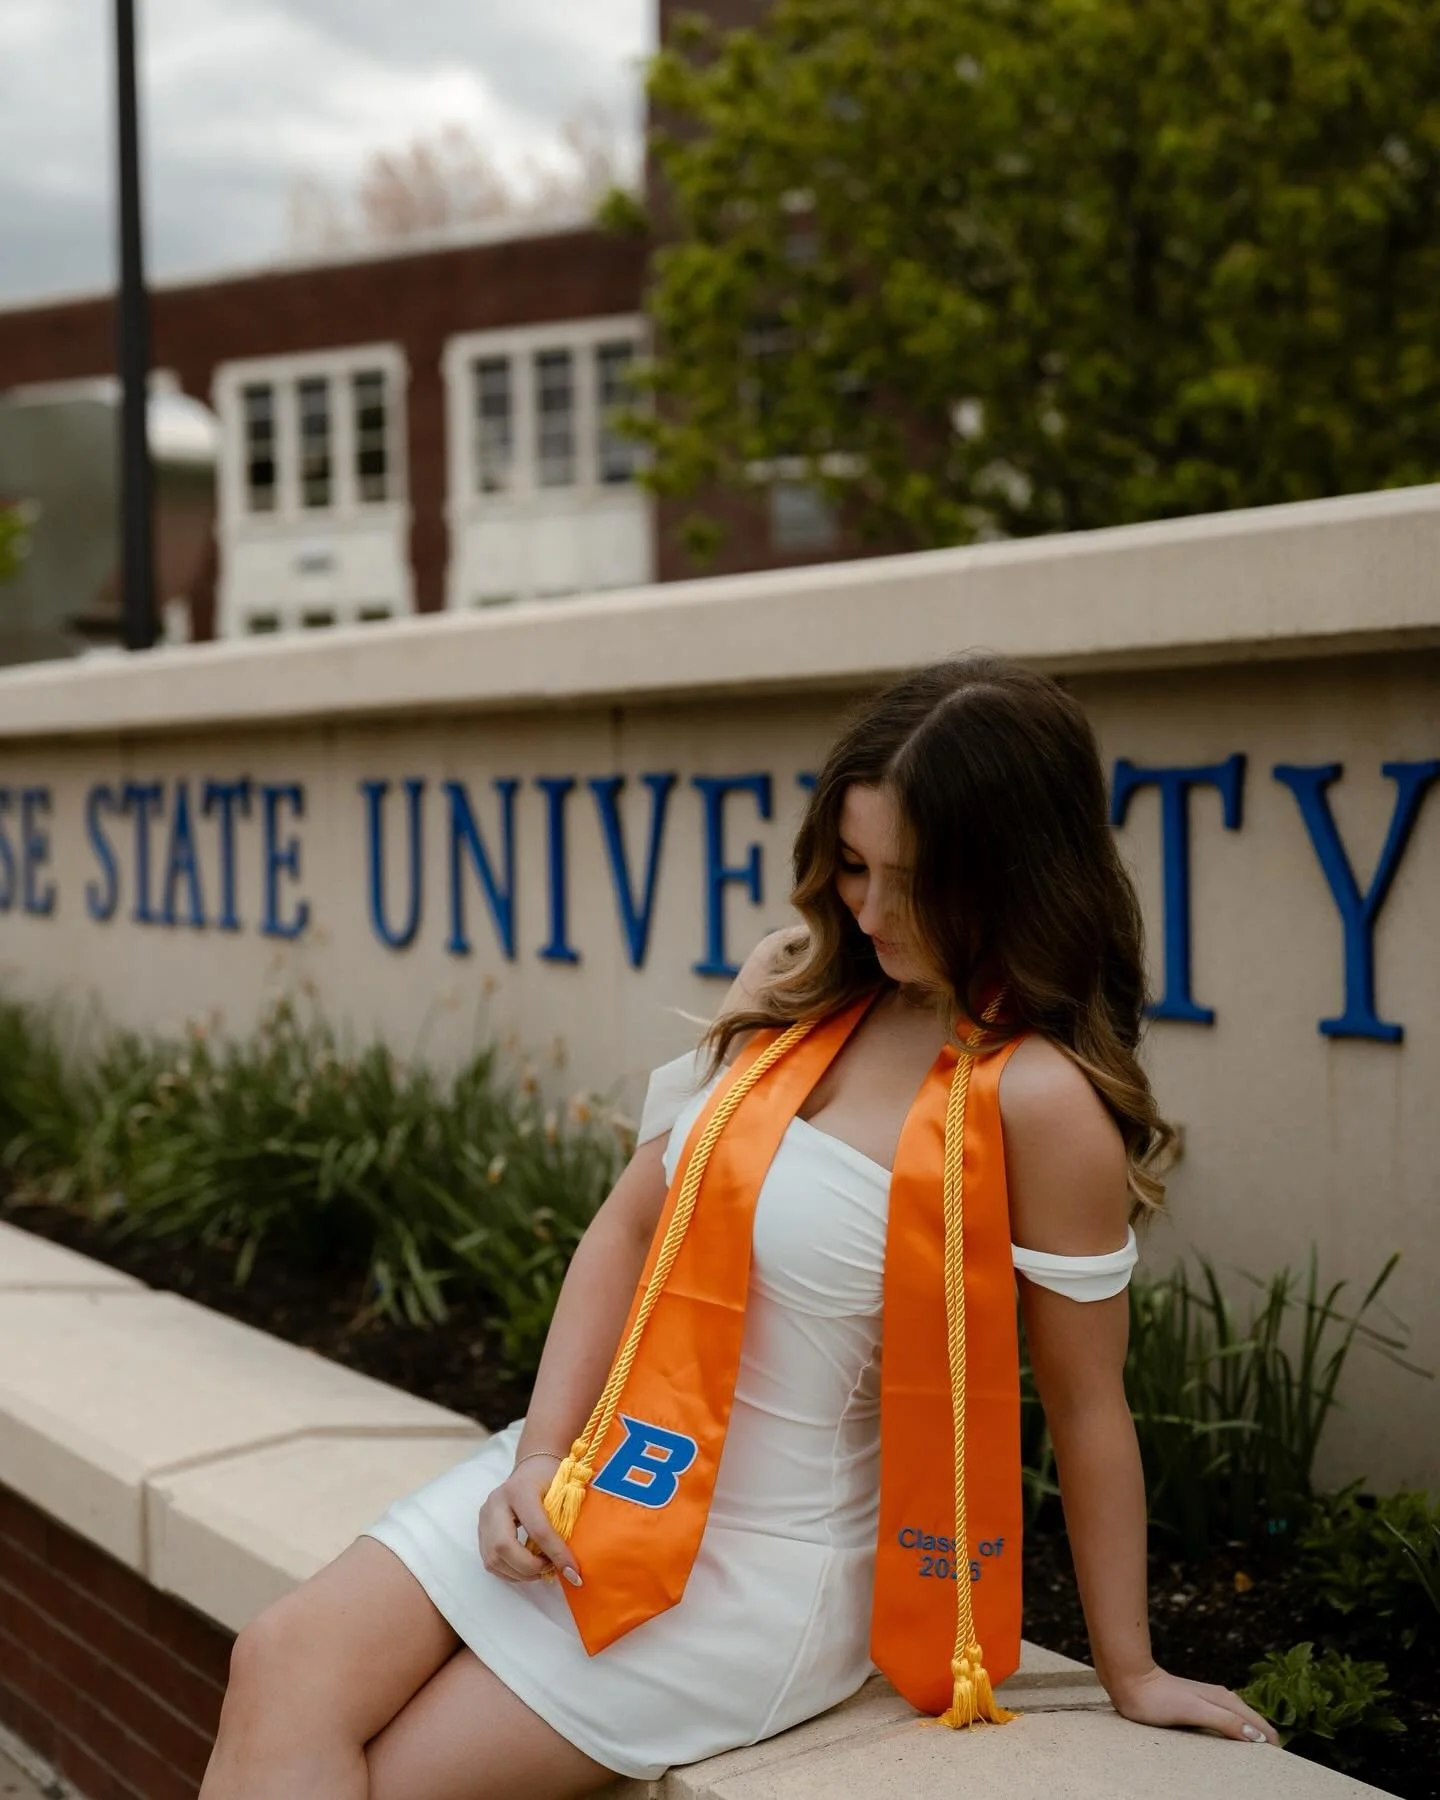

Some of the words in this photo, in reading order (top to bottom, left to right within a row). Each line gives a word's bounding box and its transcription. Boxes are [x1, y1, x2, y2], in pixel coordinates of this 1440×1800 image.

[86, 774, 309, 938] STATE
[359, 754, 1440, 1044] UNIVETY
[591, 1412, 699, 1510] B
[978, 1536, 1005, 1557] of
